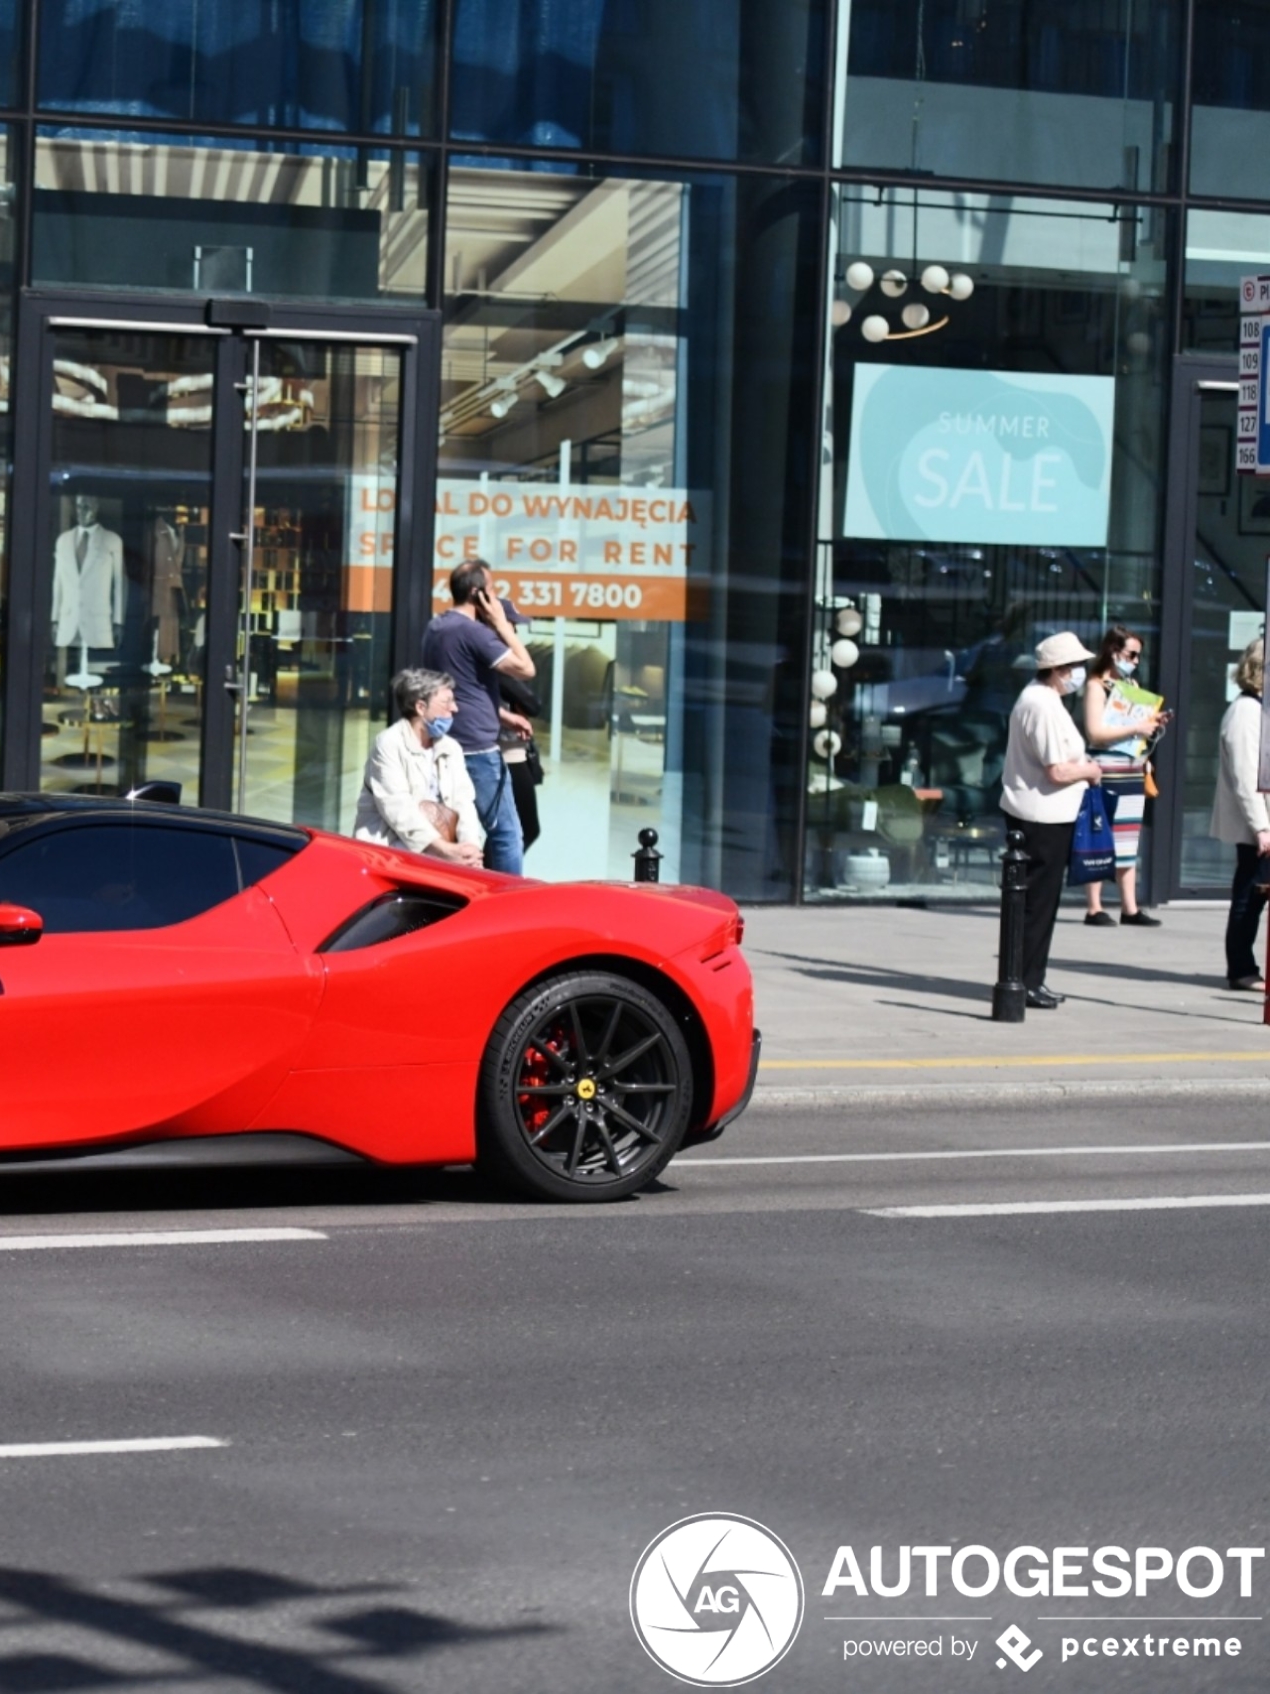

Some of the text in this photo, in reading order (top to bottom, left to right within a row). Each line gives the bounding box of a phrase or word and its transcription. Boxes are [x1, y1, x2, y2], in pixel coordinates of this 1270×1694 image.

[1243, 322, 1260, 338] 108
[1242, 354, 1259, 369] 109
[1241, 384, 1257, 400] 118
[938, 411, 1051, 438] SUMMER
[1240, 416, 1257, 432] 127
[1239, 448, 1256, 464] 166
[914, 447, 1063, 513] SALE
[468, 491, 514, 518] DO
[522, 494, 697, 529] WYNAJĘCIA
[506, 537, 578, 564] FOR
[603, 540, 697, 567] RENT
[517, 580, 562, 607] 331
[570, 582, 643, 609] 7800
